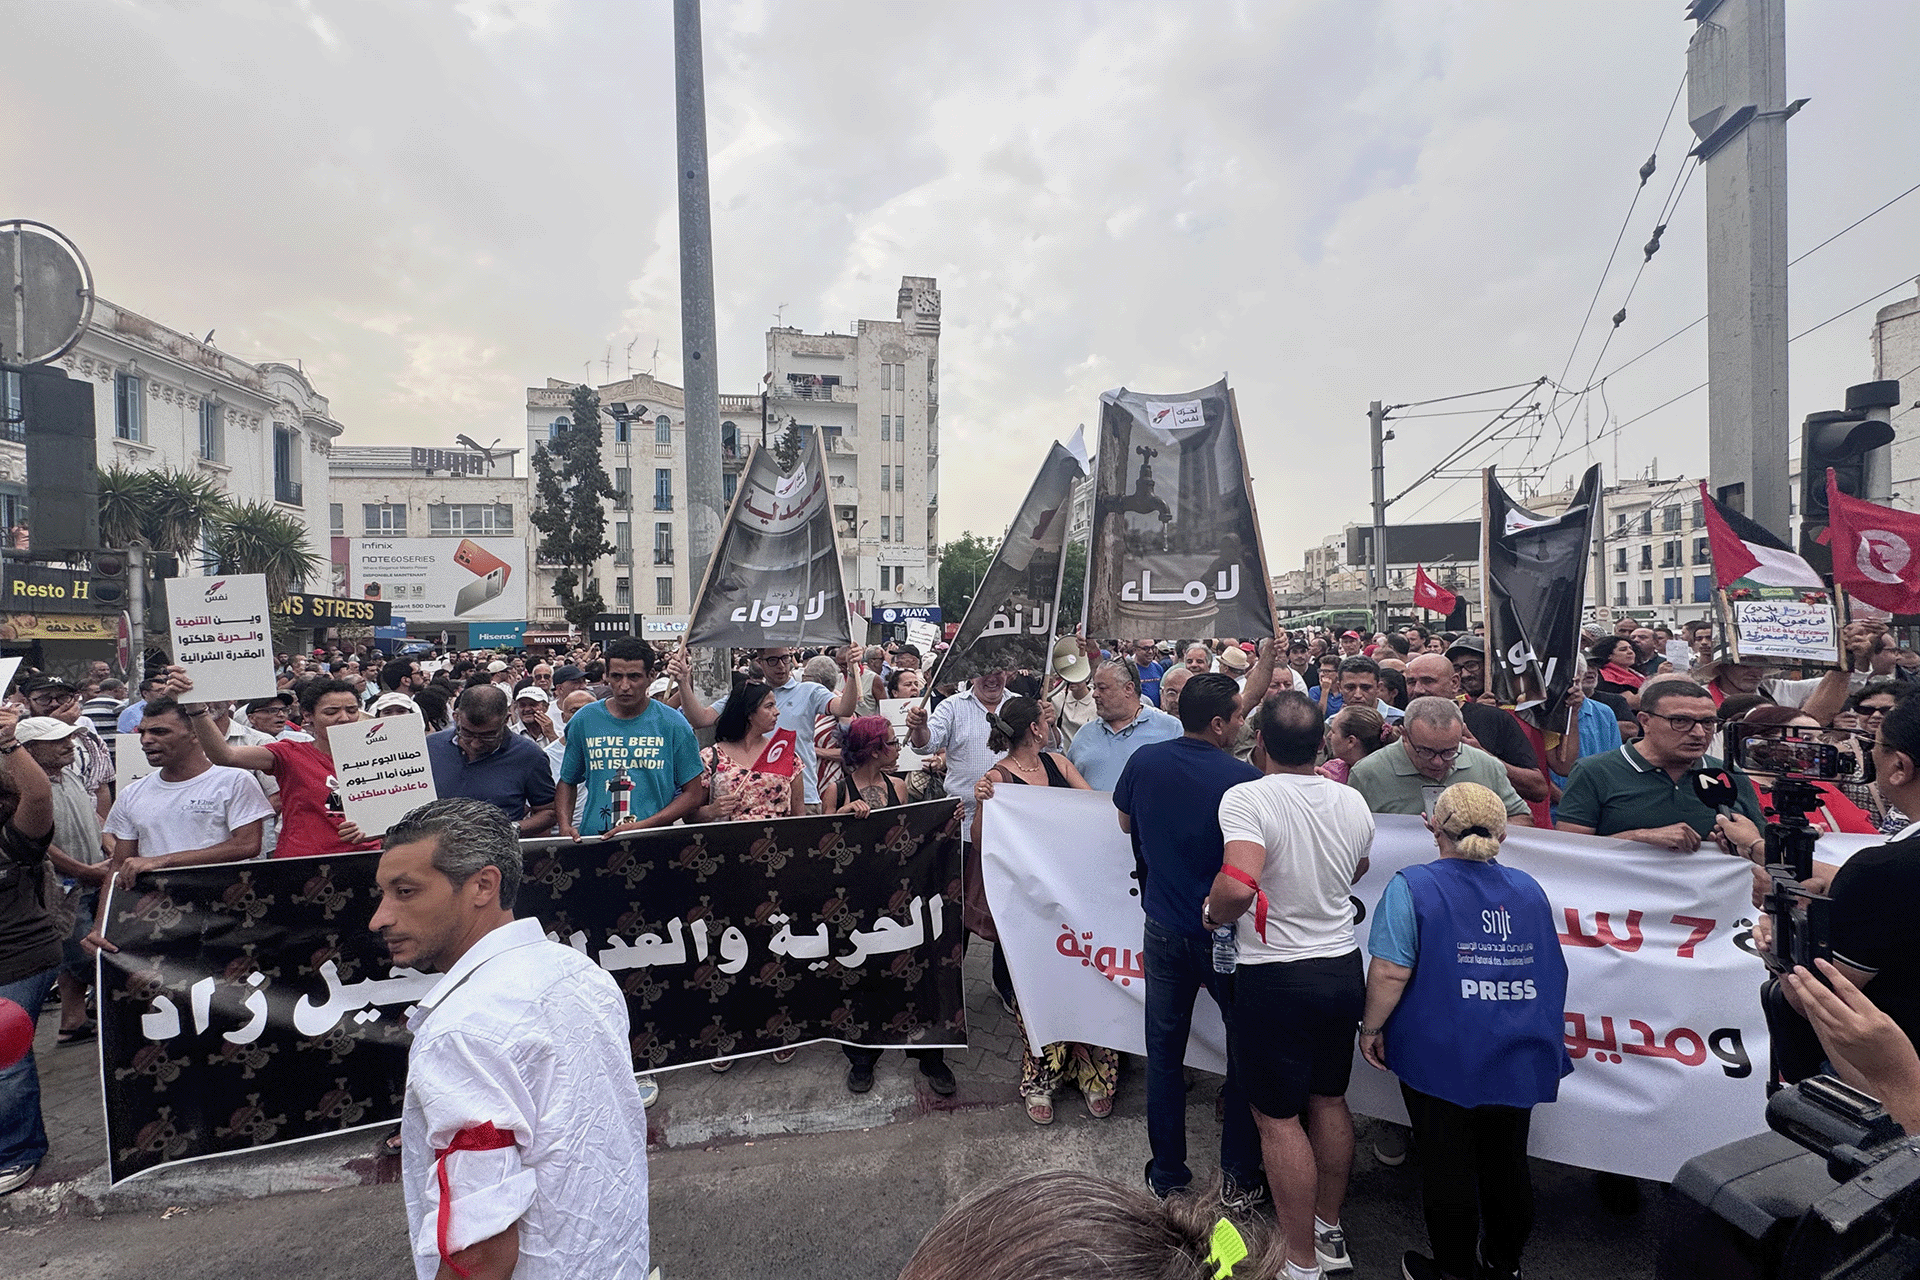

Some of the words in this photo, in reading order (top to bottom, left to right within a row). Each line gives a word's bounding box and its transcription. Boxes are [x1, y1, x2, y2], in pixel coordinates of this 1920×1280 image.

[411, 446, 483, 475] PUMA
[1121, 570, 1208, 605] ماء
[1214, 564, 1240, 600] لا
[13, 580, 65, 598] Resto
[204, 593, 228, 603] نفس
[312, 597, 374, 620] STRESS
[804, 590, 825, 621] لا
[730, 599, 799, 628] دواء
[900, 608, 931, 617] MAYA
[1029, 603, 1051, 635] لا
[73, 621, 98, 633] عند
[175, 615, 212, 628] التنمية
[178, 633, 216, 646] هلكتوا
[217, 631, 264, 643] والحرية
[533, 636, 568, 644] MANINO
[225, 648, 265, 661] المقدرة
[365, 734, 388, 745] نفس
[586, 736, 624, 748] WE'VE
[628, 736, 665, 747] BEEN
[397, 750, 421, 761] حملنا
[589, 747, 629, 759] VOTED
[633, 747, 660, 758] OFF
[342, 760, 370, 771] سبع
[371, 753, 397, 767] الجوع
[589, 760, 604, 770] HE
[608, 759, 665, 770] ISLAND!!
[384, 769, 398, 779] أما
[399, 766, 425, 777] سنين
[346, 771, 384, 787] اليوم
[417, 781, 428, 789] ما
[348, 789, 387, 802] ساكتين
[387, 783, 417, 795] عادش
[1481, 905, 1512, 942] snjt
[767, 893, 944, 972] الحرية
[1670, 914, 1717, 958] 7
[547, 917, 749, 974] والعدا
[1461, 978, 1537, 1001] PRESS
[292, 960, 445, 1037] جيل
[141, 970, 269, 1045] زاد
